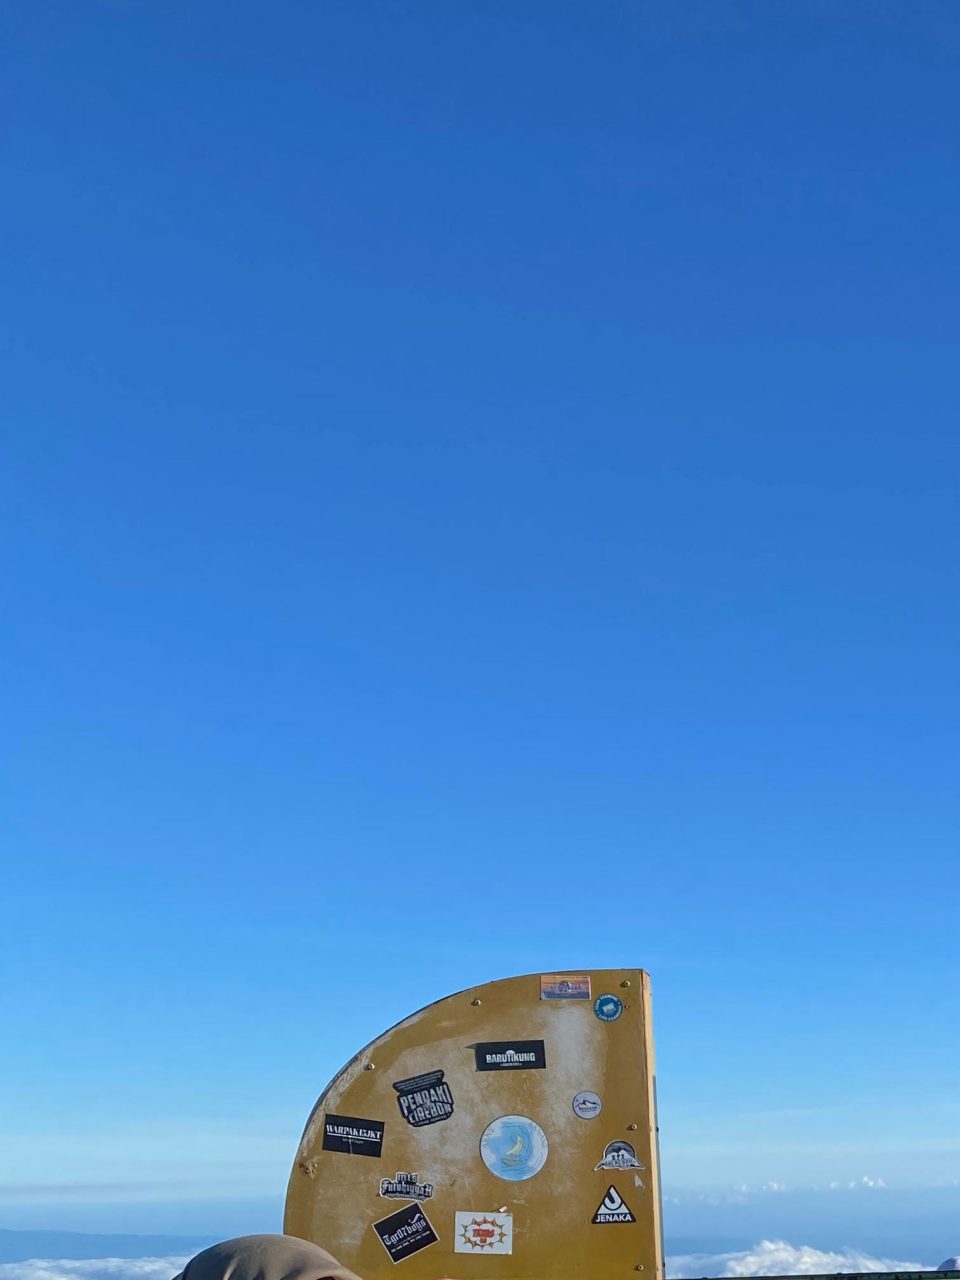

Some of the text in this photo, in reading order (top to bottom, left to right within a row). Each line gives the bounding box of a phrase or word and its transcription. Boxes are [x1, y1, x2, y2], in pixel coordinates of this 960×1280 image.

[486, 1051, 536, 1063] BARUTIKUNG
[400, 1084, 453, 1117] PENDAKI
[408, 1101, 453, 1124] CIREBON
[595, 1214, 632, 1223] JENAKA
